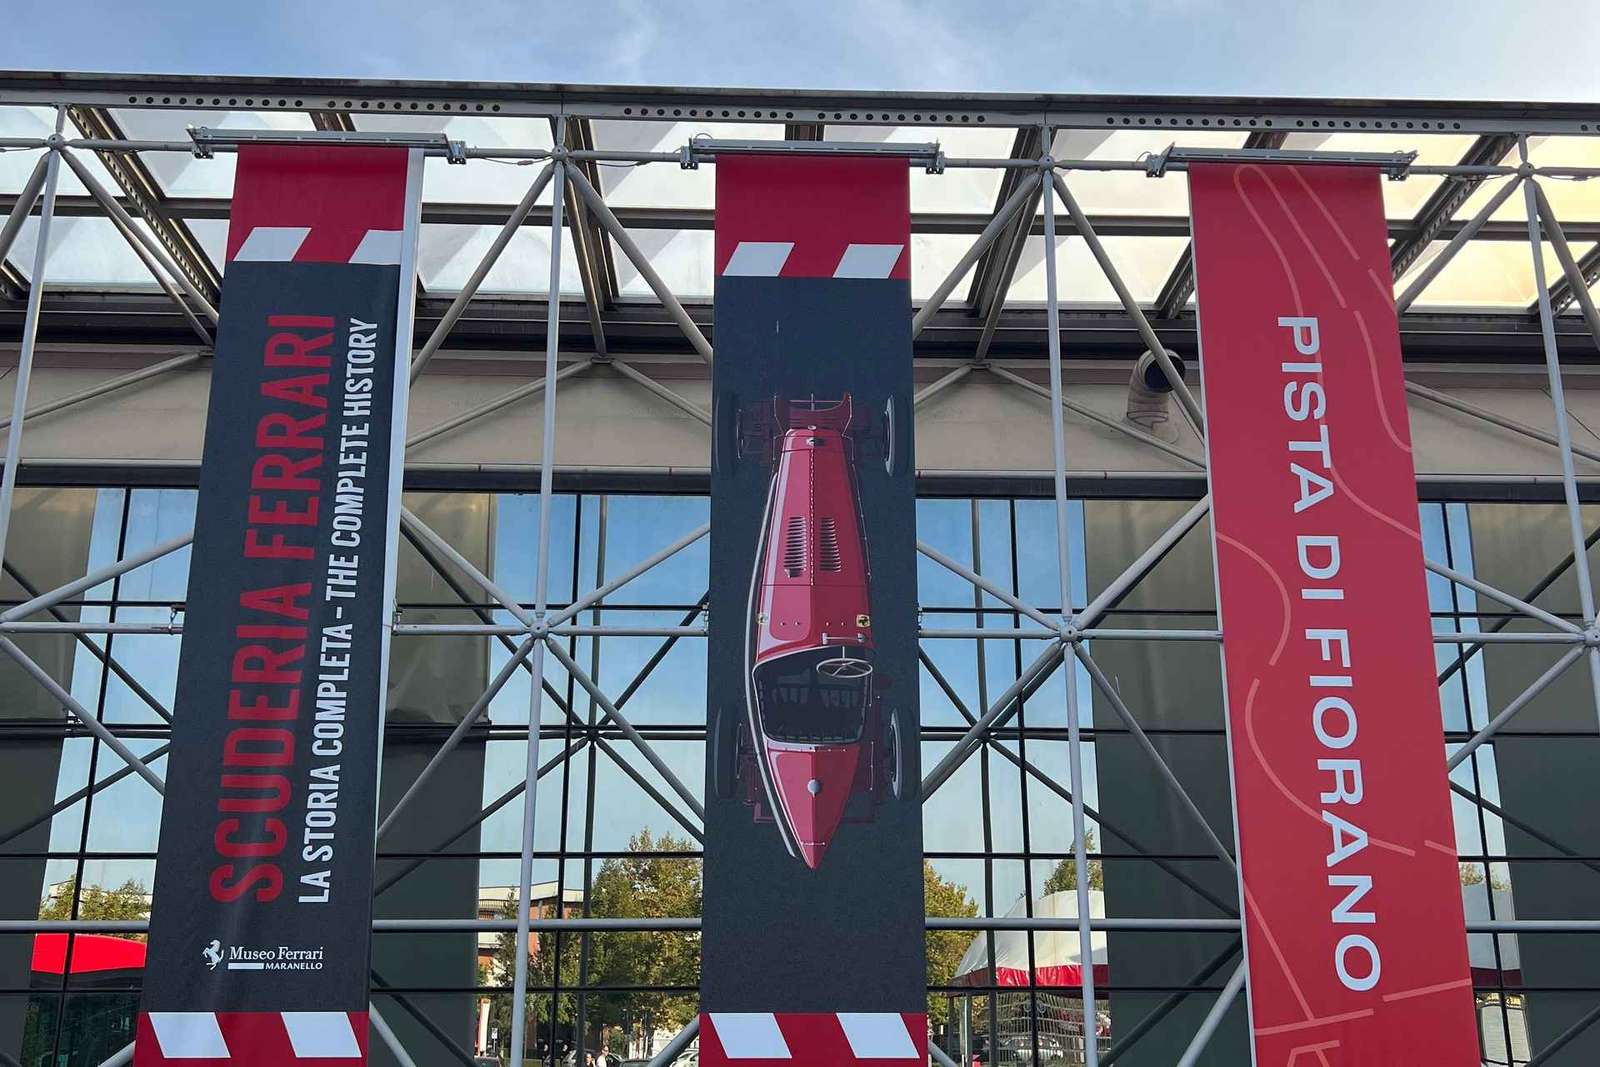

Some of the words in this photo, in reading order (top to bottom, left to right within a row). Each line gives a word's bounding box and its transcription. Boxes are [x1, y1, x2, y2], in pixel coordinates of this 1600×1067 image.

[342, 317, 379, 417] HISTORY
[1277, 316, 1335, 513] PISTA
[244, 314, 336, 560] FERRARI
[331, 422, 370, 548] COMPLETE
[325, 554, 359, 601] THE
[1296, 535, 1345, 600] DI
[311, 623, 353, 757] COMPLETA
[209, 582, 312, 904] SCUDERIA
[302, 764, 341, 863] STORIA
[1304, 628, 1382, 992] FIORANO
[298, 869, 331, 904] LA
[229, 946, 276, 960] Museo
[277, 946, 324, 960] Ferrari
[265, 962, 323, 970] MARANELLO
